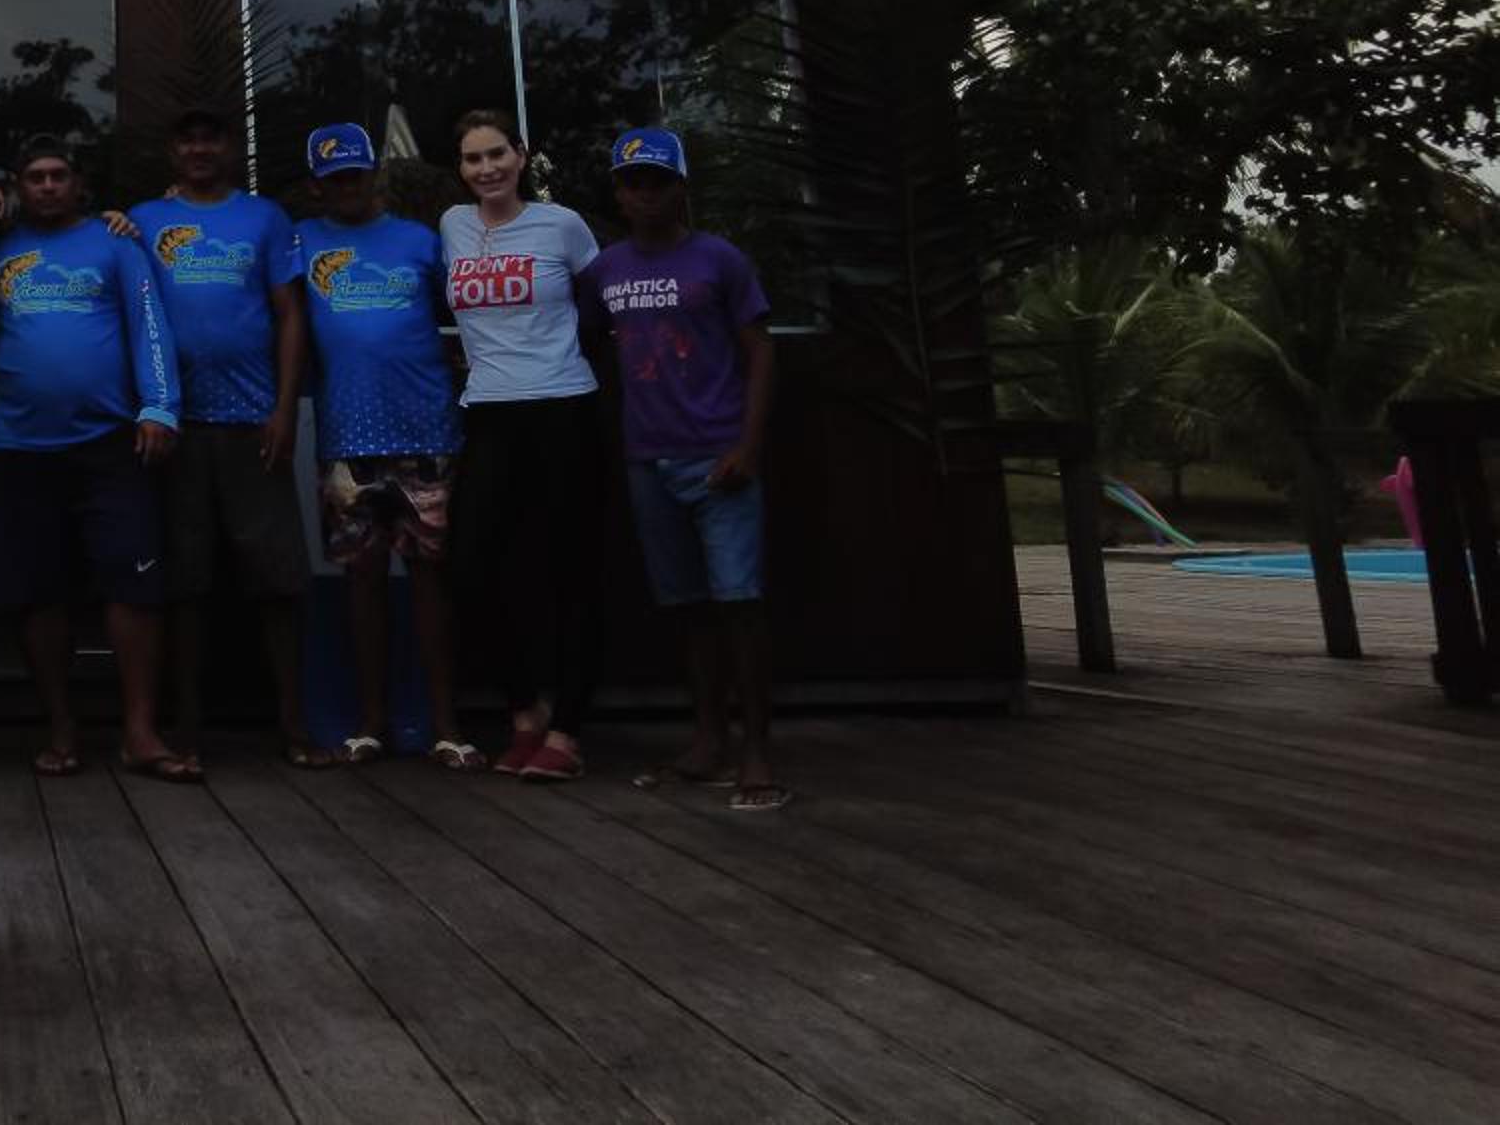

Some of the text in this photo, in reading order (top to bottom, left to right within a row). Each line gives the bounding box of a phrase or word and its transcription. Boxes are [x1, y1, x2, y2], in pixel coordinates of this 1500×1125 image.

[460, 256, 531, 276] DON'T
[450, 277, 530, 308] FOLD
[629, 293, 678, 308] AMOR
